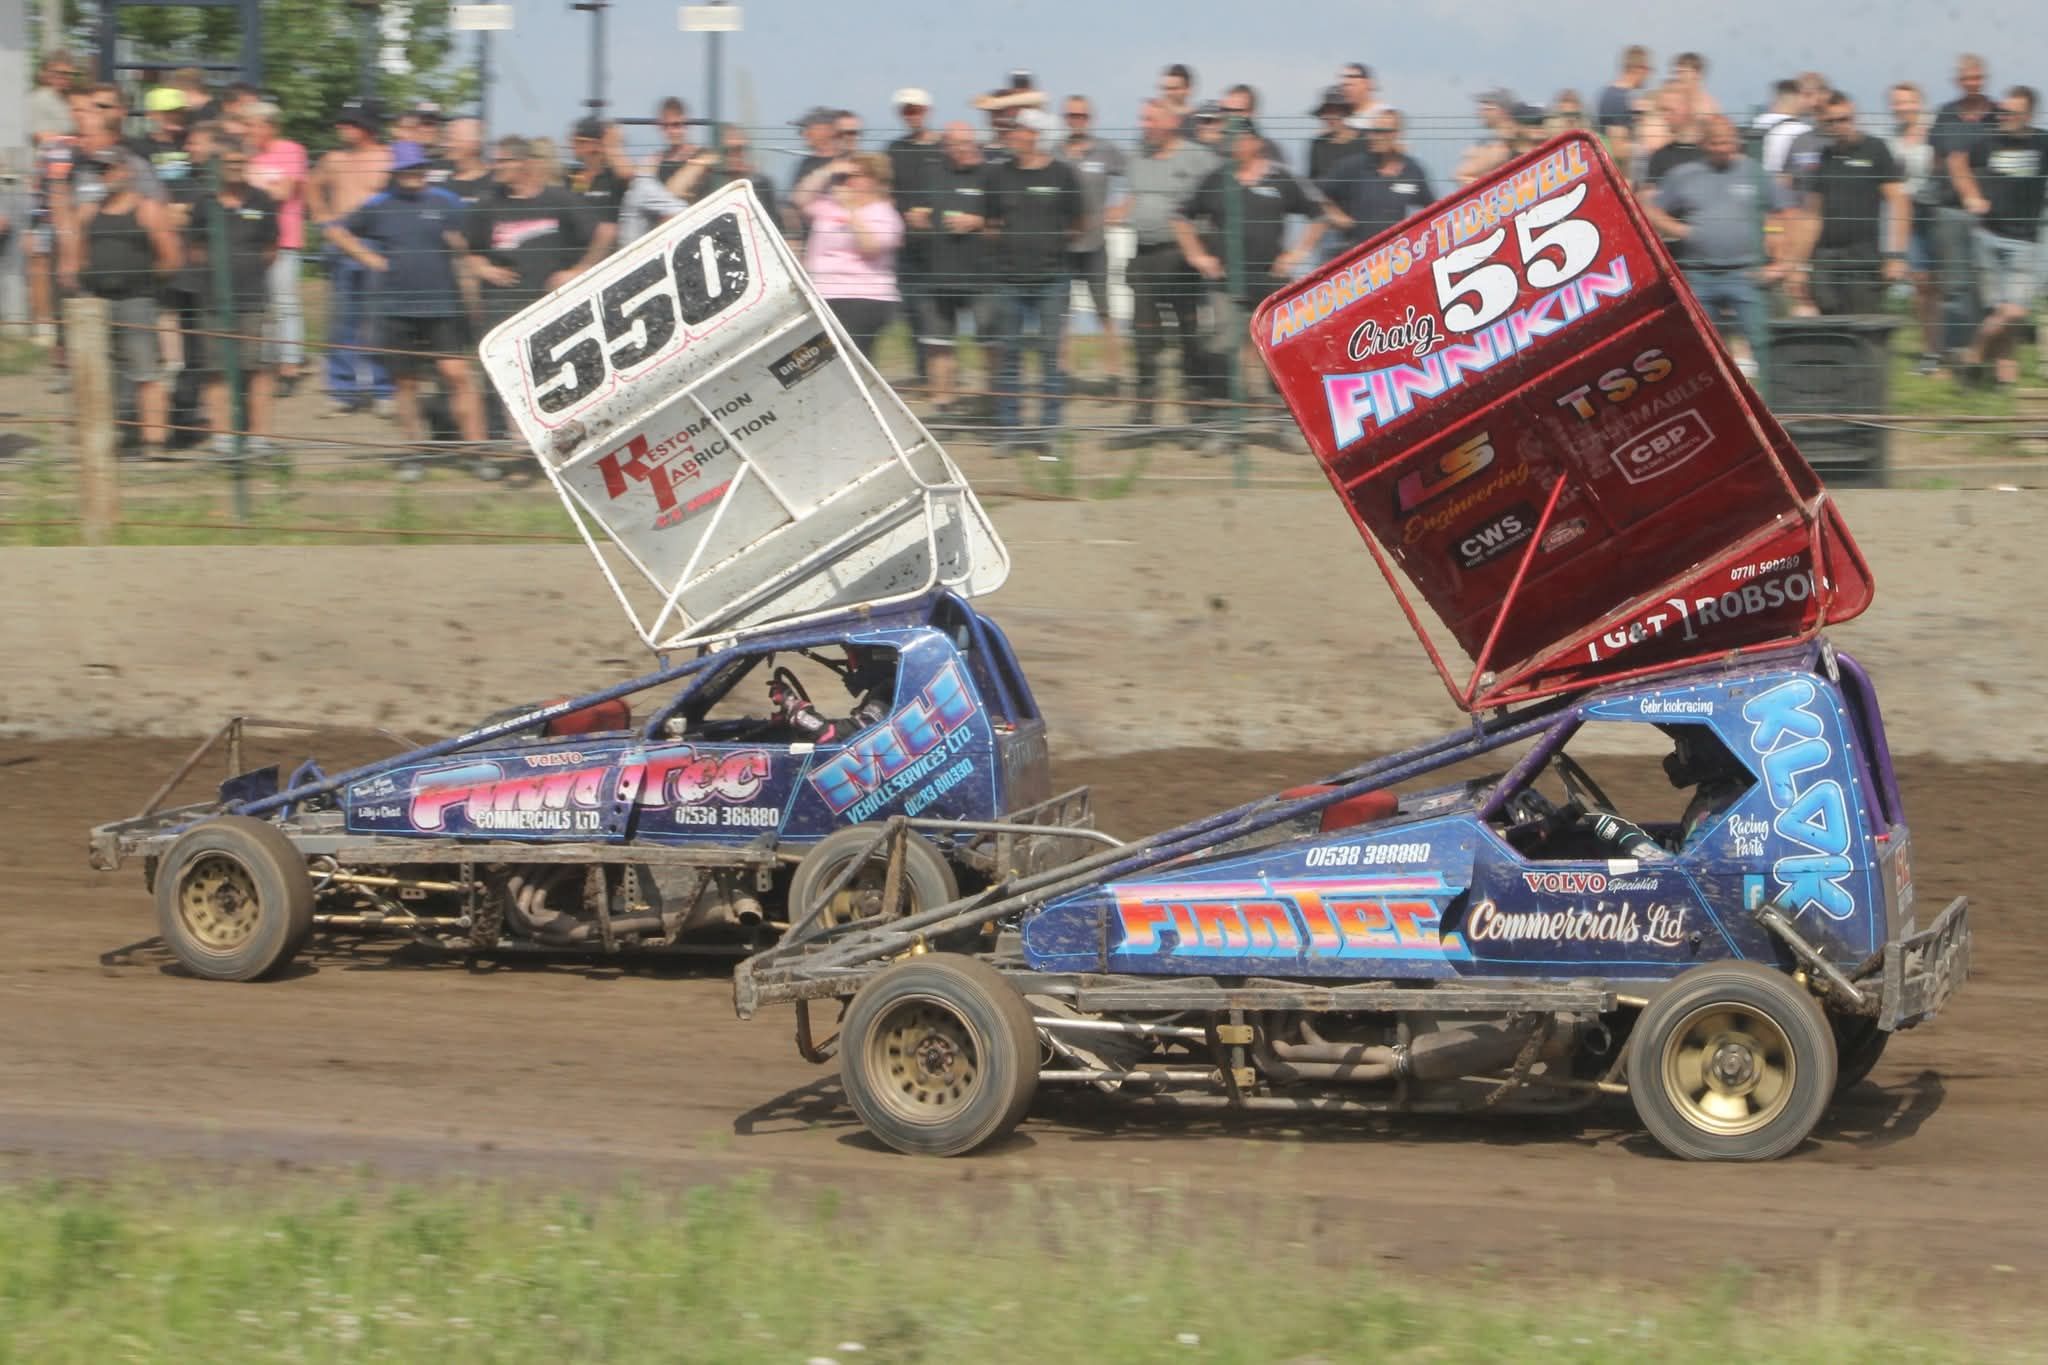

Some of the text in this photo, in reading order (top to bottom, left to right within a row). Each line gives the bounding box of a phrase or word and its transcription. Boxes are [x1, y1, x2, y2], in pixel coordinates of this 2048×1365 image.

[1271, 141, 1589, 346] ANDREWS of TIDESWELL
[1431, 182, 1601, 334] 55
[526, 211, 749, 415] 550
[1347, 305, 1444, 362] Craig
[1322, 255, 1632, 450] FINNIKIN
[1557, 348, 1673, 420] TSS
[1630, 424, 1688, 465] CBP
[1398, 431, 1495, 512] LS
[1402, 463, 1530, 545] Engineering
[1460, 514, 1523, 558] CWS
[1730, 563, 1757, 581] 07711
[524, 751, 584, 768] VOLVO
[845, 783, 898, 825] VEHICLE
[890, 745, 948, 794] SERVICES
[903, 784, 939, 817] 01283
[476, 810, 571, 830] COMMERCIALS
[1728, 813, 1770, 841] Racing
[1305, 847, 1361, 867] 01538
[1735, 837, 1765, 858] Parts
[1522, 872, 1607, 894] VOLVO
[1468, 899, 1688, 947] Commercials Ltd
